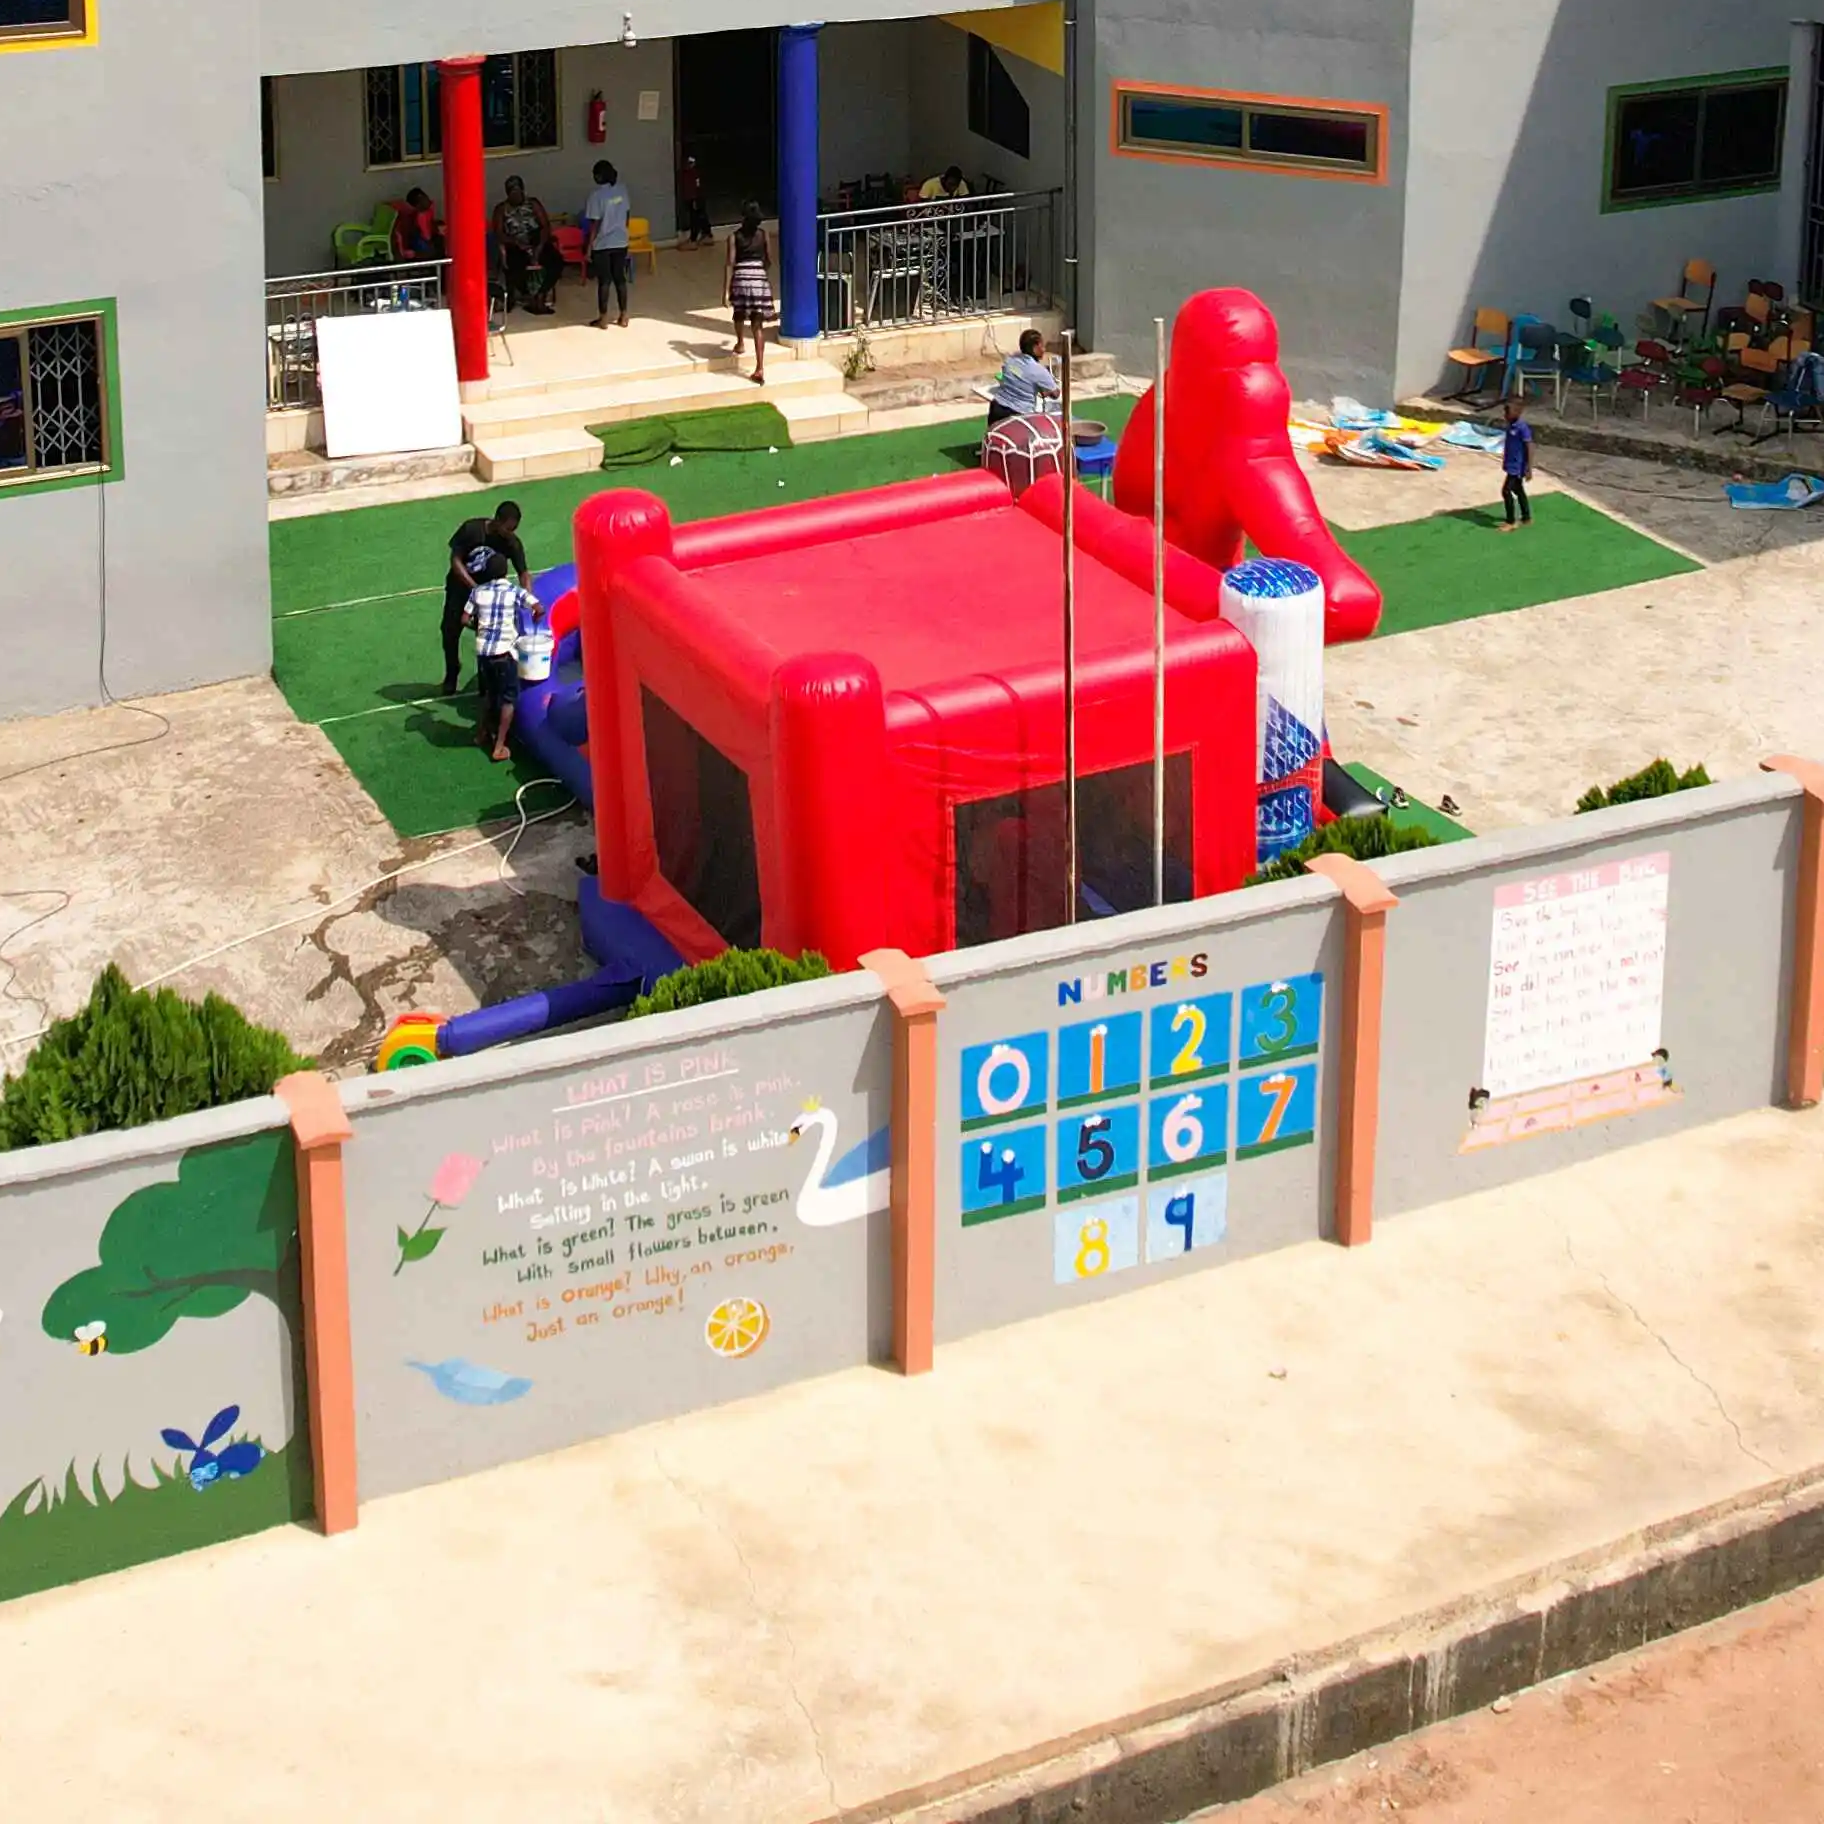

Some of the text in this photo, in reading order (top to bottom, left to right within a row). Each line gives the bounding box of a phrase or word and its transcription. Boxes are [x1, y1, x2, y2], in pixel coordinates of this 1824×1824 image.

[1522, 878, 1558, 904] SEE
[1569, 870, 1600, 894] THE
[1058, 953, 1208, 1006] NUMBERS
[567, 1049, 739, 1104] WHAT IS PINK
[977, 985, 1298, 1116] 0 1 2 3
[492, 1128, 542, 1154] What
[555, 1119, 573, 1143] is
[646, 1102, 662, 1122] A
[673, 1091, 719, 1116] rose
[532, 1157, 559, 1179] By
[567, 1149, 596, 1168] the
[605, 1121, 699, 1160] fountains
[978, 1076, 1297, 1203] 4 5 6 7
[497, 1187, 544, 1214] What
[560, 1178, 578, 1198] is
[648, 1158, 663, 1177] A
[670, 1150, 715, 1171] swan
[722, 1139, 738, 1158] is
[747, 1128, 789, 1152] white
[601, 1193, 617, 1212] in
[624, 1189, 651, 1209] the
[661, 1174, 709, 1203] light.
[482, 1188, 790, 1266] What is green? The grass is green
[517, 1220, 778, 1283] With small flowers between.
[1075, 1192, 1195, 1278] 8 9
[482, 1300, 524, 1325] What
[536, 1294, 551, 1312] is
[690, 1259, 712, 1276] an
[526, 1288, 685, 1342] Just an orange!
